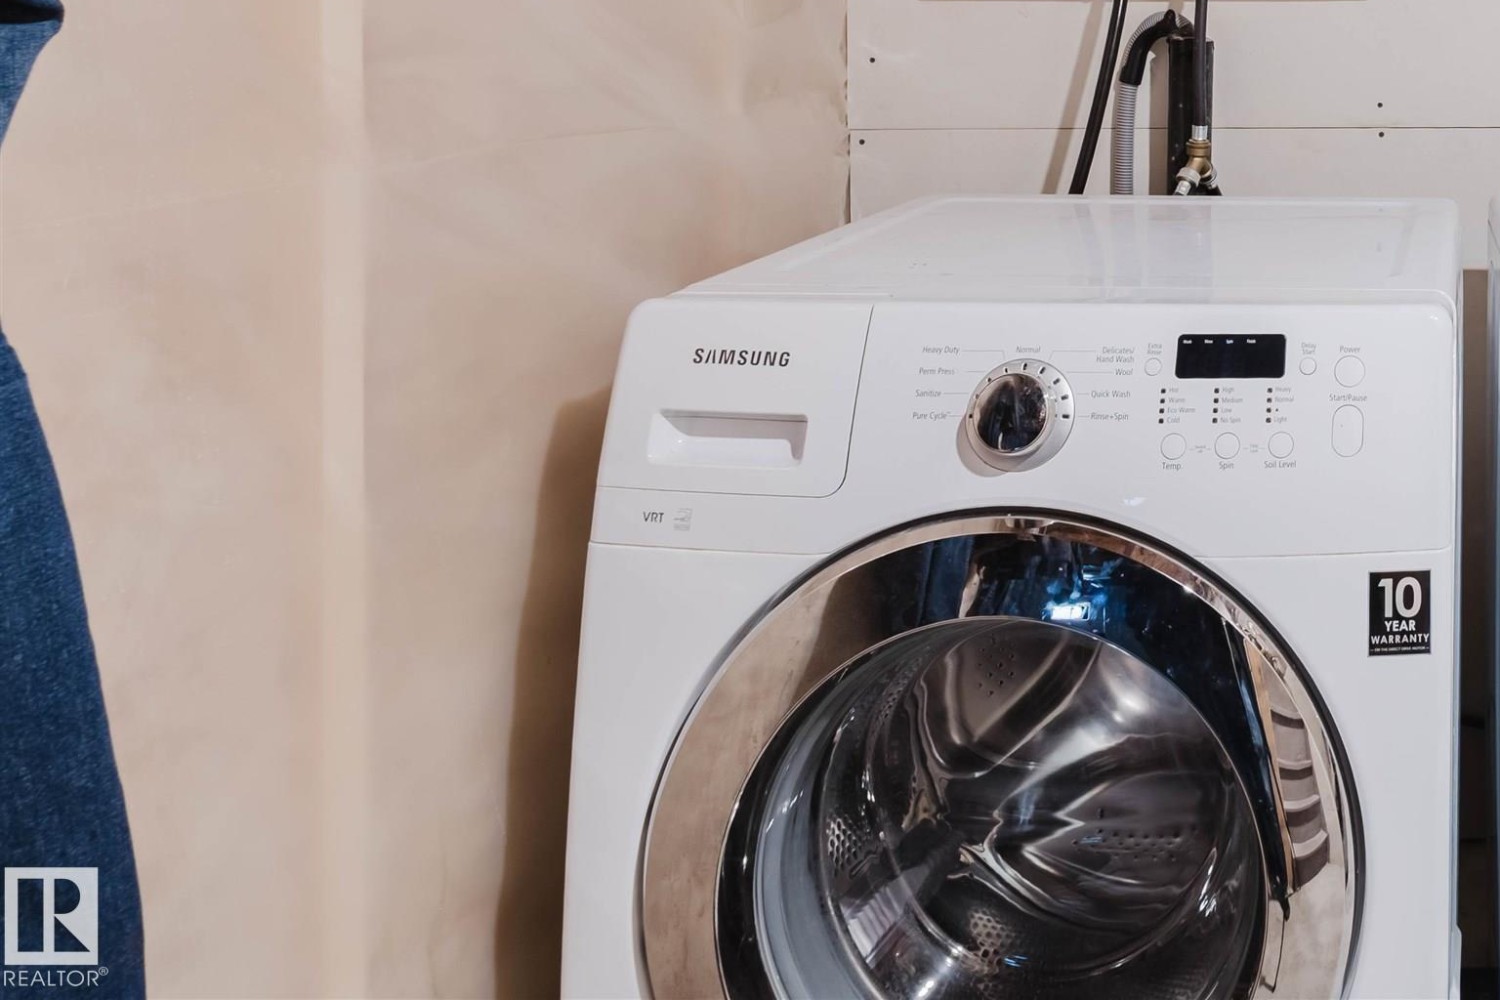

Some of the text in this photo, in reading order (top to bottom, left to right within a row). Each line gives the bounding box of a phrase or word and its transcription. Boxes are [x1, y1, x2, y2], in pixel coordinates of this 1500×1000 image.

[693, 348, 790, 367] SAMSUNG
[1219, 461, 1234, 470] Spin
[1264, 460, 1296, 468] Soil Level
[643, 511, 664, 523] VRT
[1378, 576, 1422, 618] 10
[1384, 619, 1416, 632] YEAR
[1370, 633, 1430, 645] WARRANTY
